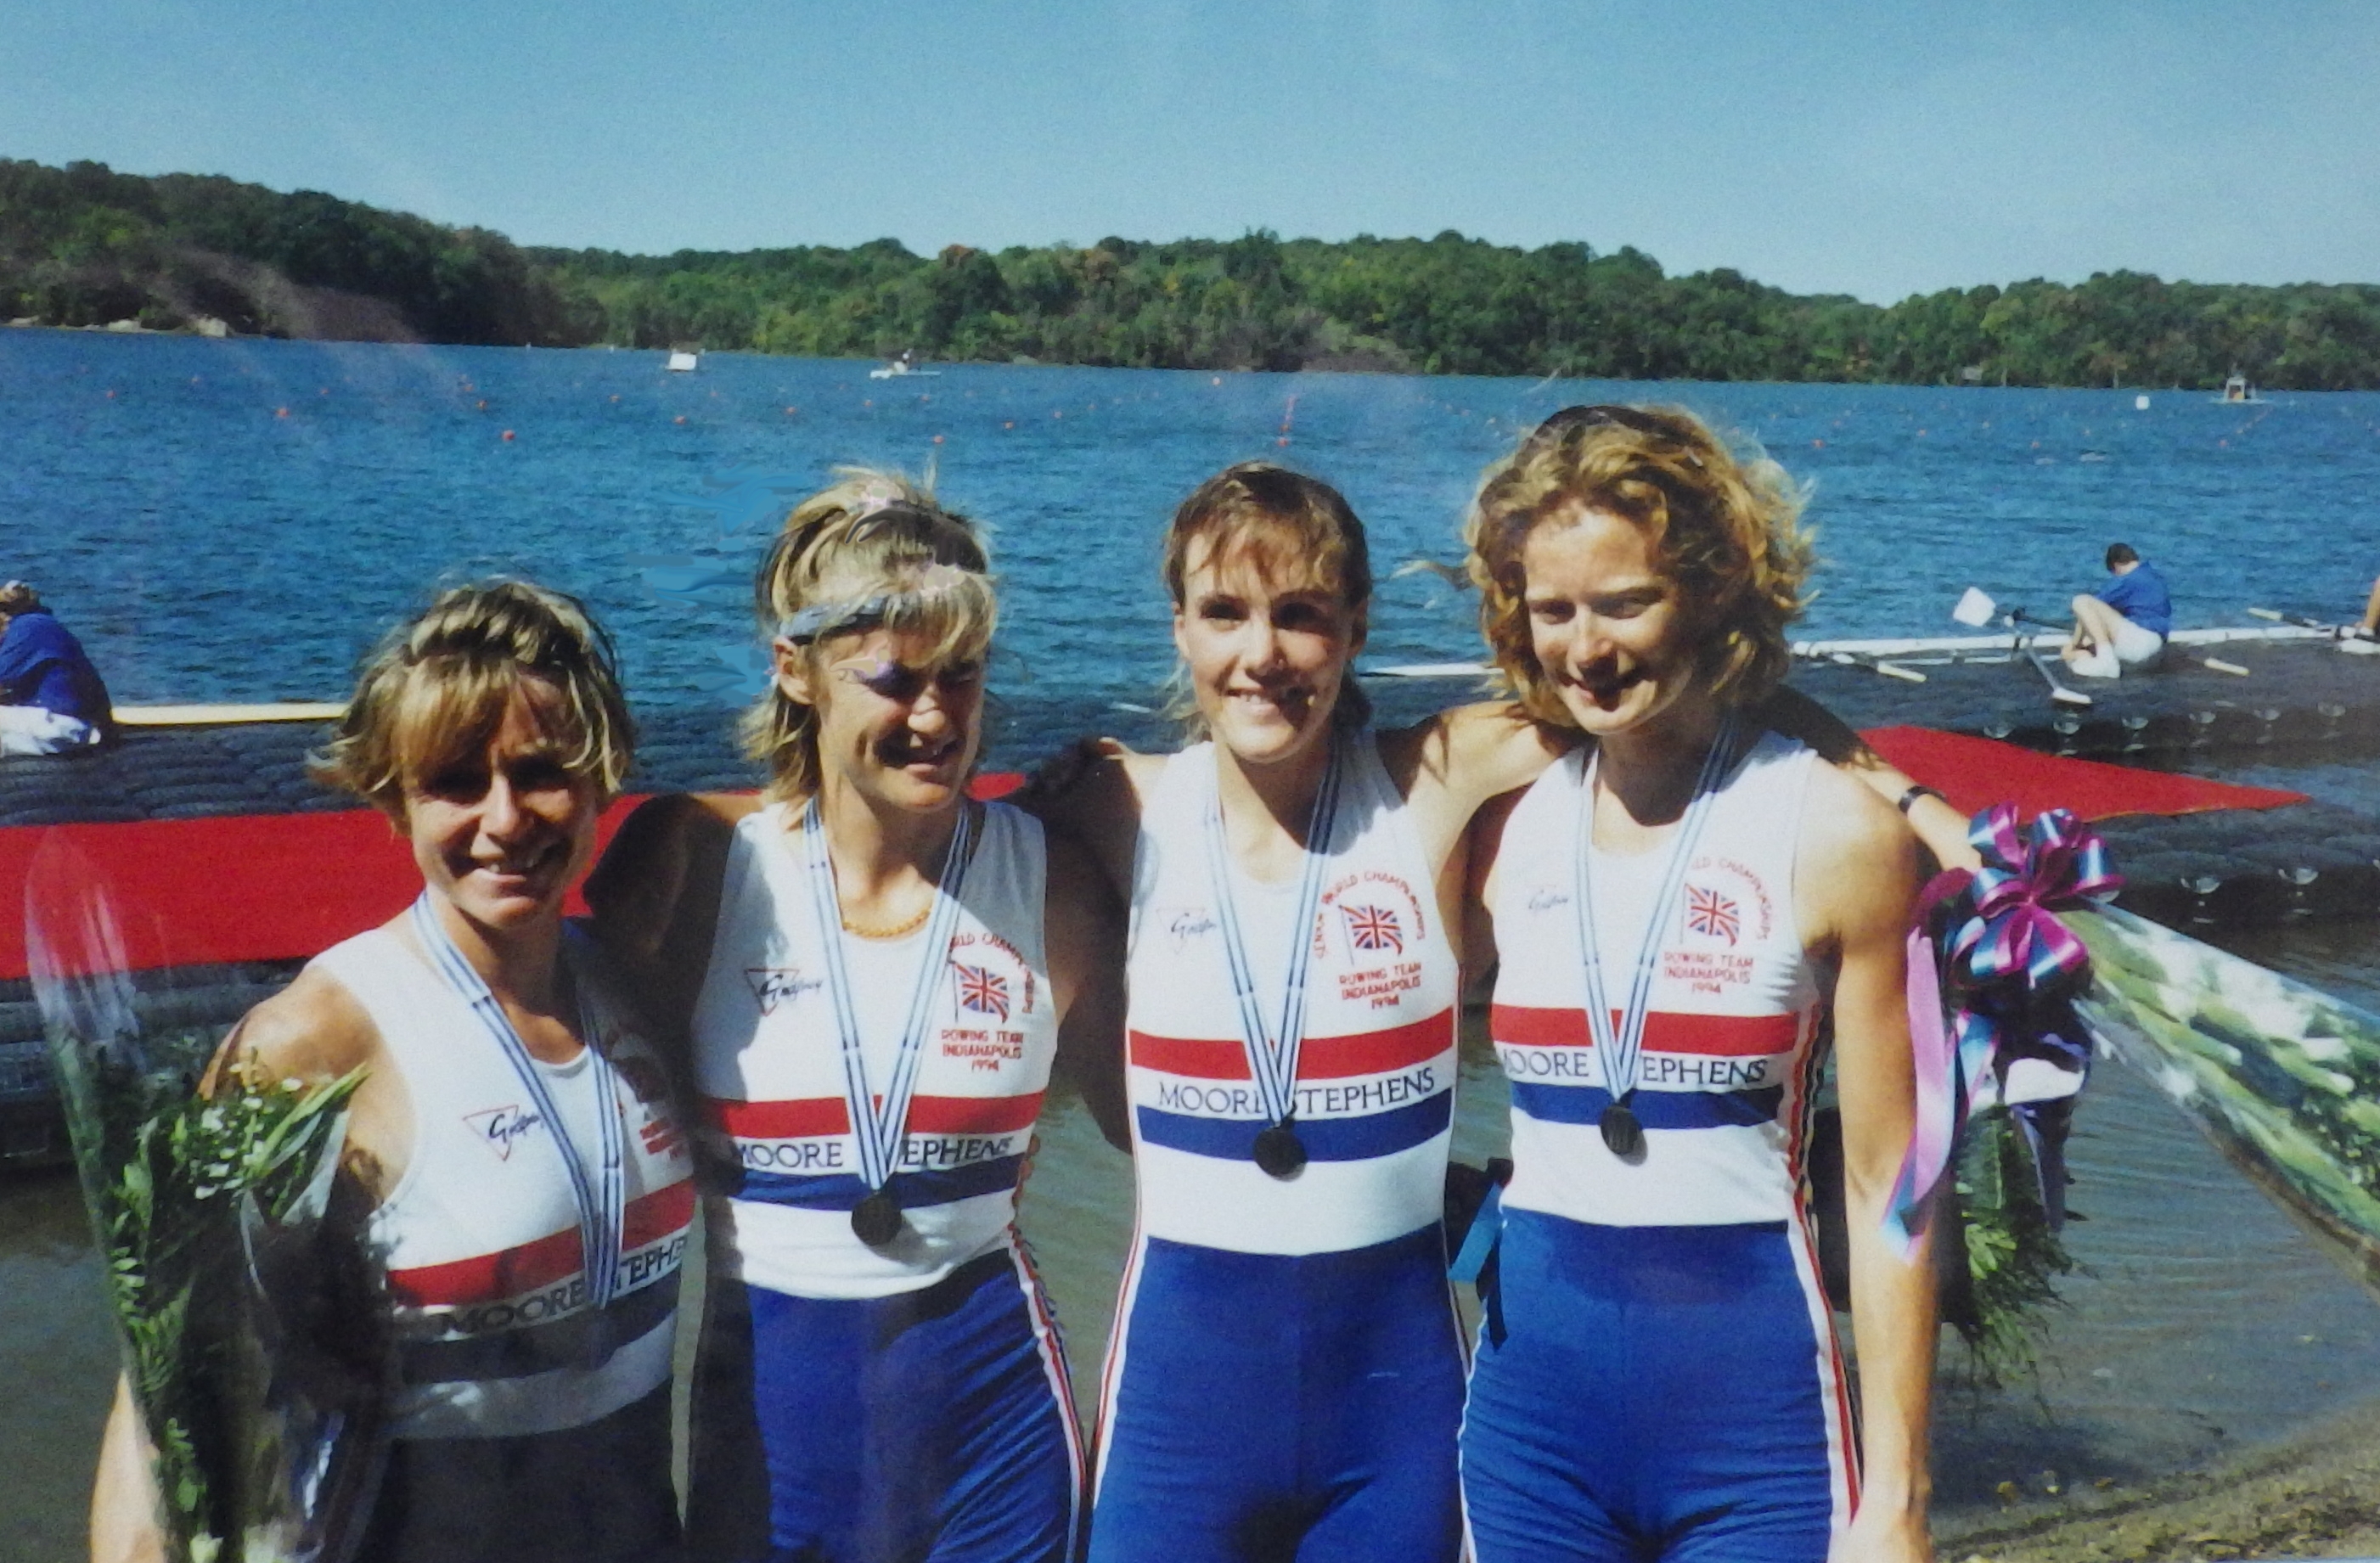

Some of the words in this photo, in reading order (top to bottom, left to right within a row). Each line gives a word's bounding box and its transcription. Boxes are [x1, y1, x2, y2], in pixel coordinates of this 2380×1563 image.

[1664, 952, 1713, 964] ROWING
[1721, 954, 1753, 967] TEAM
[1339, 968, 1387, 984] ROWING
[1394, 962, 1421, 975] TEAM
[1664, 966, 1751, 984] INDIANAPOLIS
[1342, 975, 1421, 1000] INDIANAPOLIS
[941, 1029, 988, 1042] ROWING
[996, 1030, 1024, 1043] TEAM
[942, 1043, 1021, 1059] INDIANAPOLIS
[1642, 1056, 1769, 1085] EPHENS
[1292, 1066, 1435, 1115] TEPHENS
[902, 1136, 1014, 1166] EPHENS
